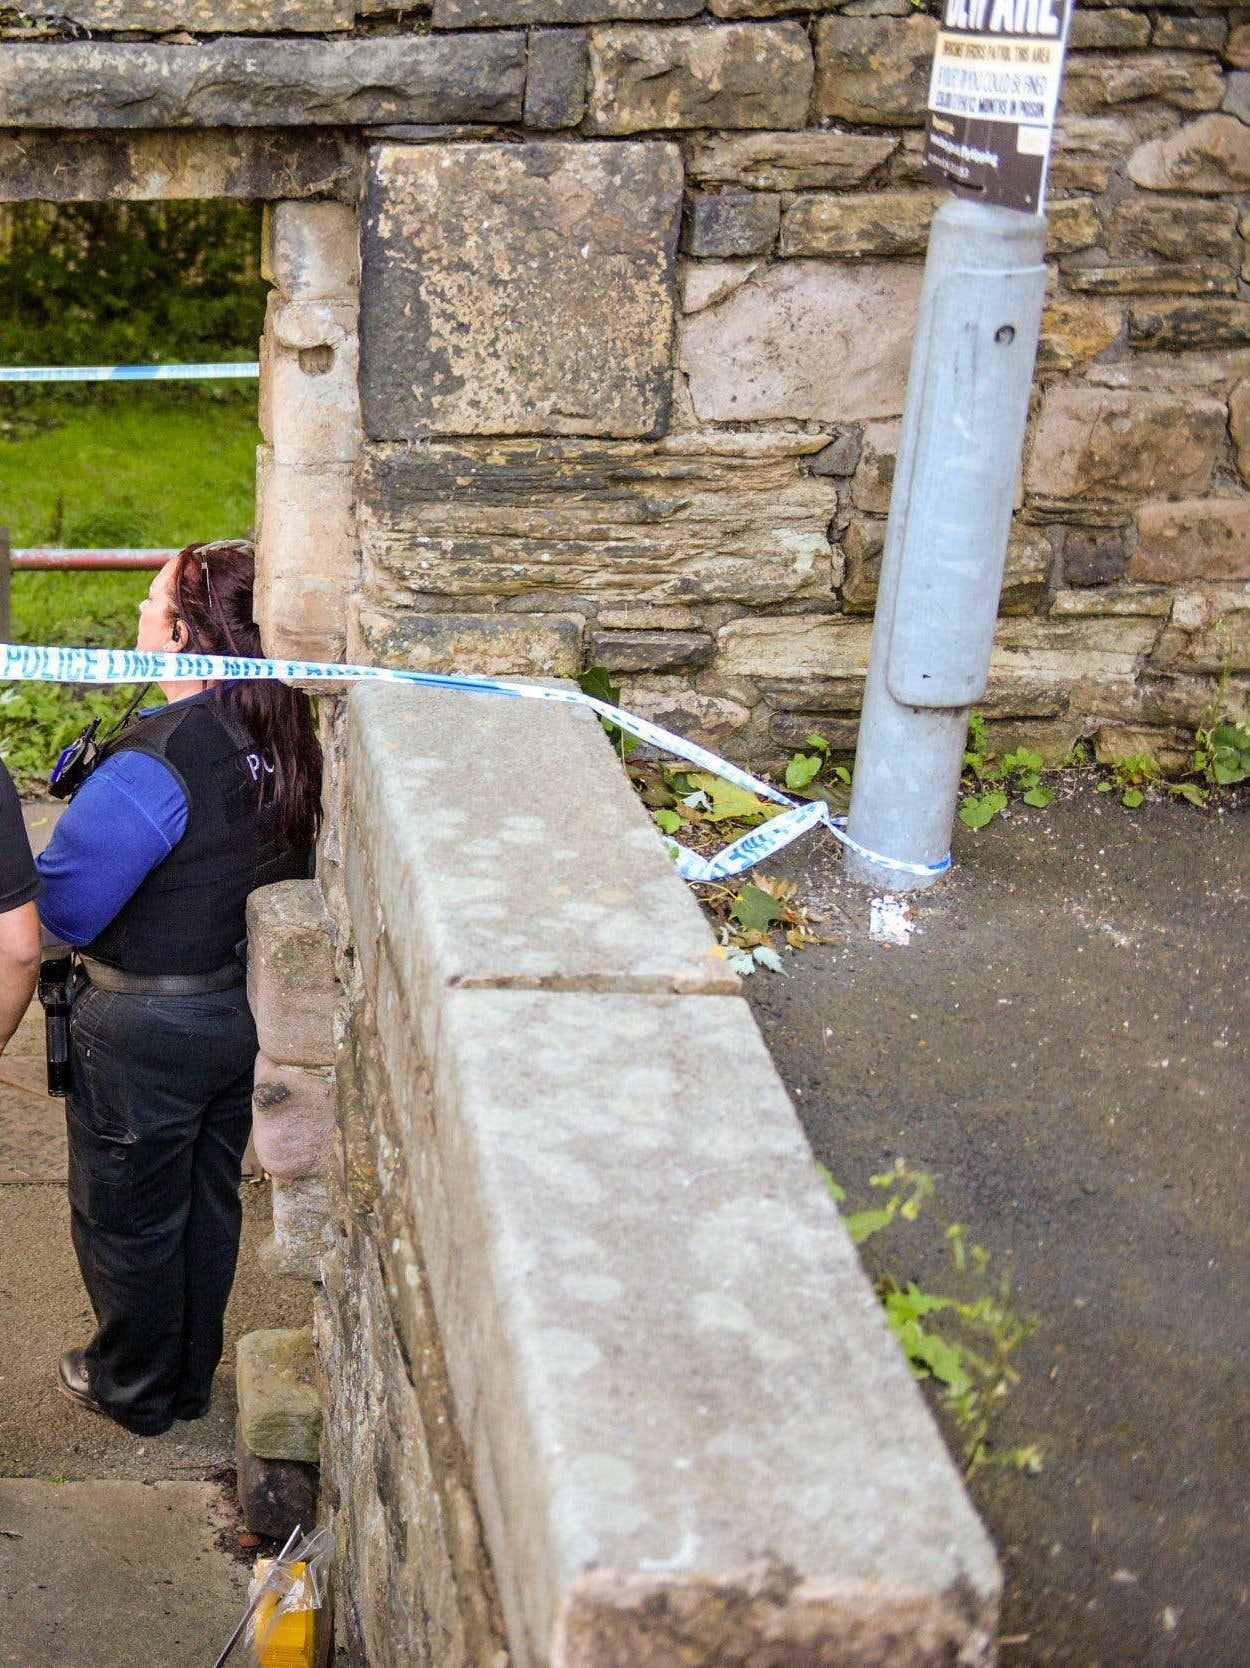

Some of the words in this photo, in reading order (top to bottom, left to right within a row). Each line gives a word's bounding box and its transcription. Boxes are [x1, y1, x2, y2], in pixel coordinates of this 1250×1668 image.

[3, 643, 99, 681] POLICE
[106, 647, 166, 679] LINE
[174, 653, 213, 677] DO
[222, 657, 277, 677] NOT
